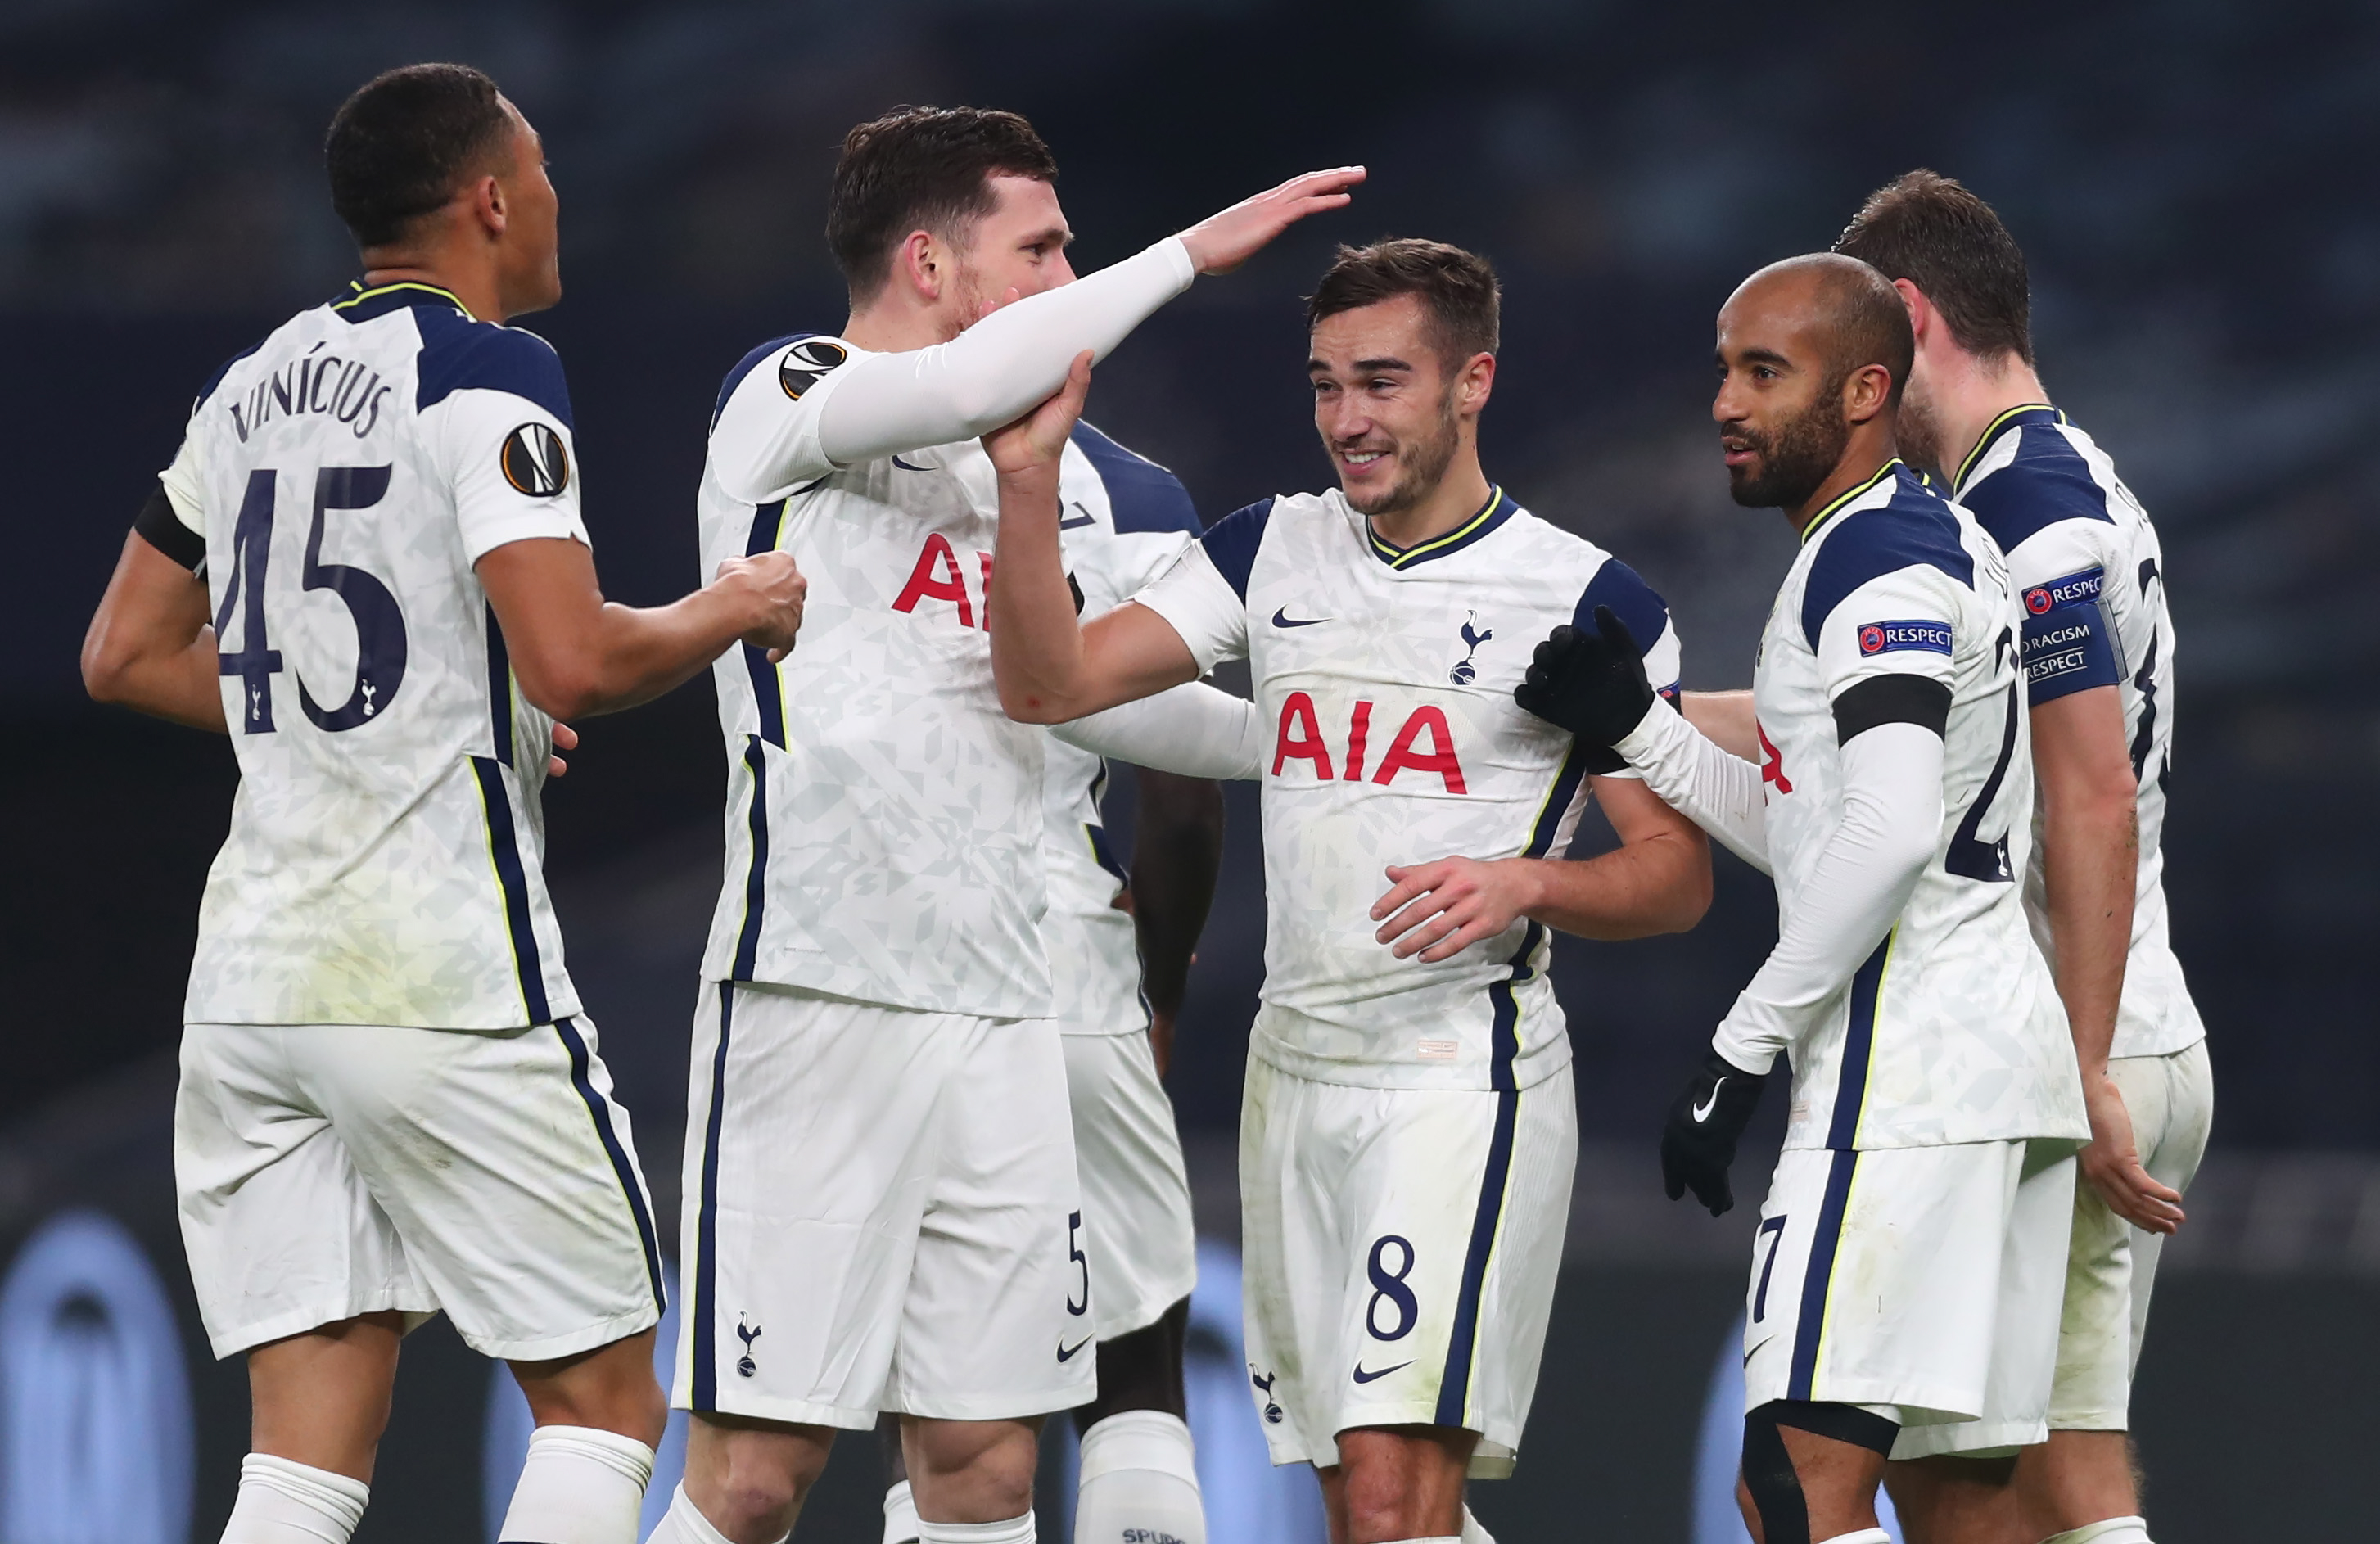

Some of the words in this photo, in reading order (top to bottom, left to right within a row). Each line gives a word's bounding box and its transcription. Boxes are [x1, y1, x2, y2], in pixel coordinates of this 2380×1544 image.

[230, 341, 391, 443] VINÍCIUS
[216, 461, 408, 735] 45
[891, 533, 992, 633] AI
[2053, 576, 2103, 603] RESPEC
[1886, 628, 1952, 647] RESPECT
[2031, 625, 2090, 650] RACISM
[1271, 692, 1468, 795] AIA
[1067, 1208, 1089, 1316] 5
[1366, 1235, 1418, 1342] 8
[1753, 1214, 1788, 1324] 7
